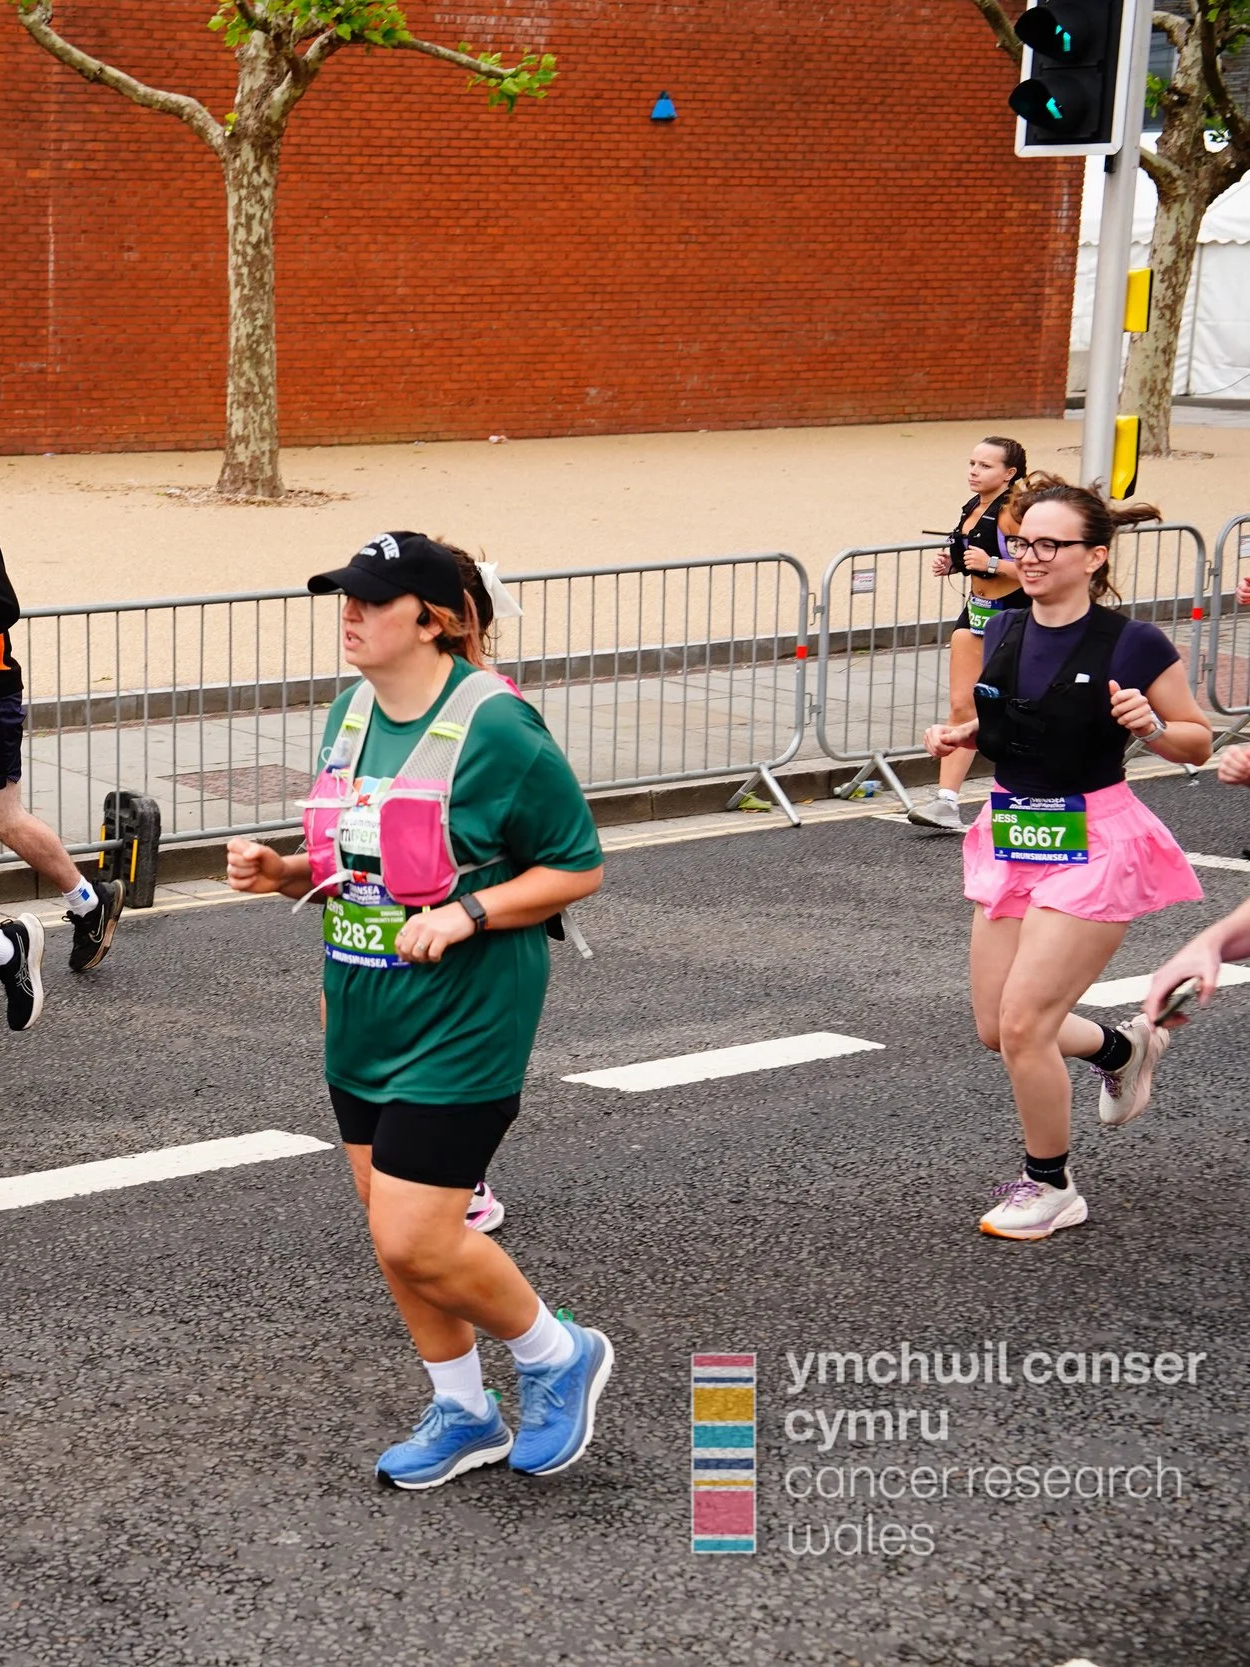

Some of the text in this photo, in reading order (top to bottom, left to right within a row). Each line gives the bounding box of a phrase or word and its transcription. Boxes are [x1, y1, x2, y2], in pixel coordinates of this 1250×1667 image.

[992, 813, 1018, 824] JESS
[1009, 825, 1067, 848] 6667
[332, 915, 385, 951] 3282
